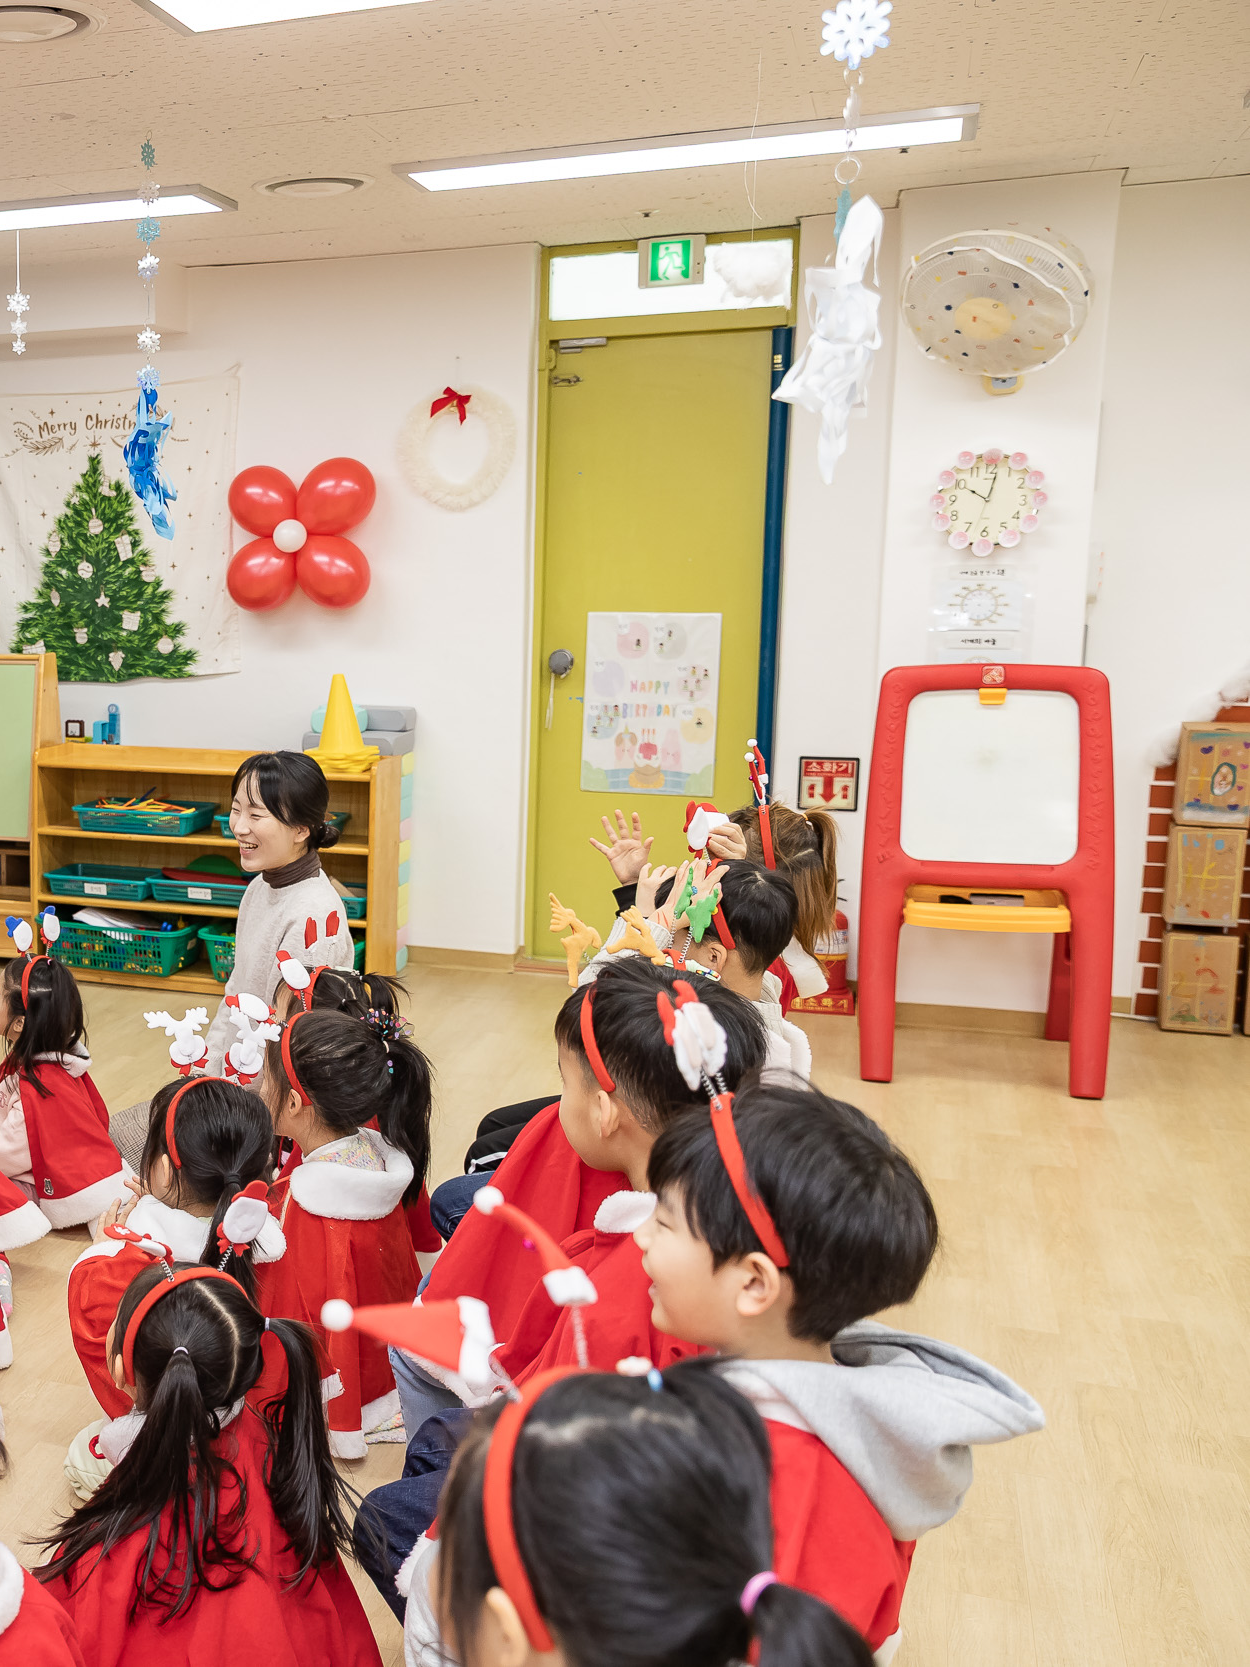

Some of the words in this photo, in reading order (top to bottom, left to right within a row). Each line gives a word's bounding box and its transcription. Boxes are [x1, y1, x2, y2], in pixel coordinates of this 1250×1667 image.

[38, 421, 77, 439] Merry
[970, 466, 979, 478] 11
[985, 463, 997, 474] 12
[1008, 467, 1012, 477] 1
[955, 478, 966, 490] 10
[1017, 477, 1025, 489] 2
[949, 494, 957, 506] 9
[1019, 495, 1027, 506] 3
[950, 510, 958, 521] 8
[1012, 510, 1020, 520] 4
[965, 522, 972, 532] 7
[980, 526, 989, 537] 6
[630, 680, 670, 694] HAPPY
[622, 703, 678, 718] BIRTHDAY
[806, 762, 853, 774] 소화기
